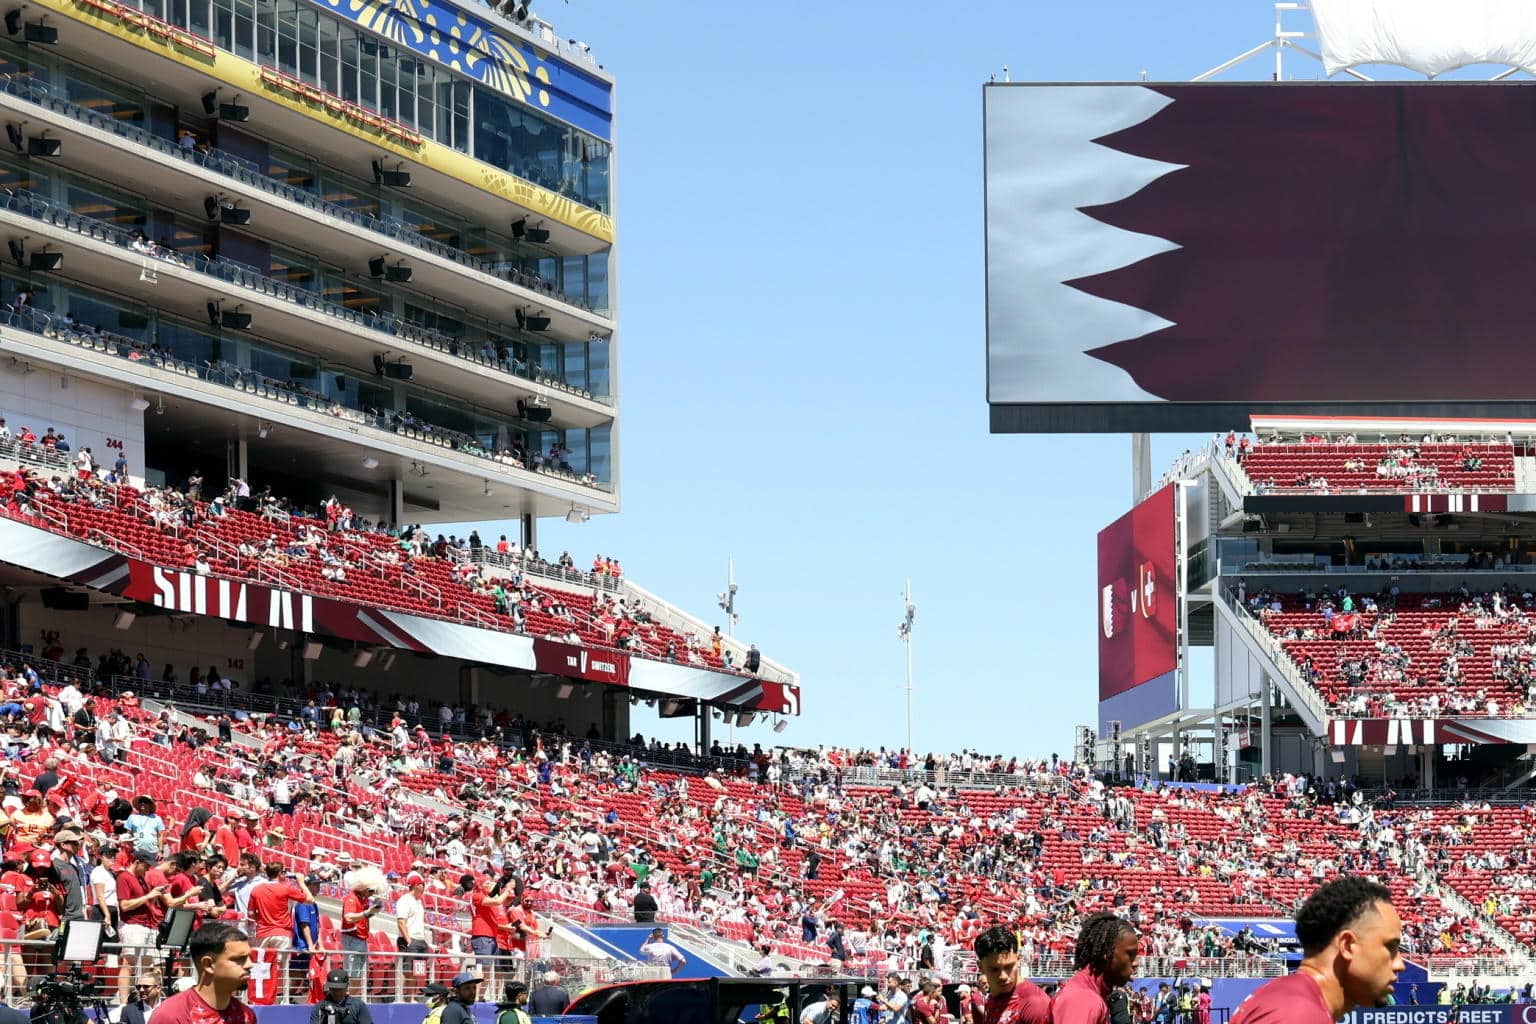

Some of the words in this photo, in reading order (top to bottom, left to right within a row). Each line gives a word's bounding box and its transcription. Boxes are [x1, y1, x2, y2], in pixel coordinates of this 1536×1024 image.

[106, 438, 123, 450] 244
[580, 651, 588, 674] V
[1363, 1009, 1503, 1024] PREDICTSREET
